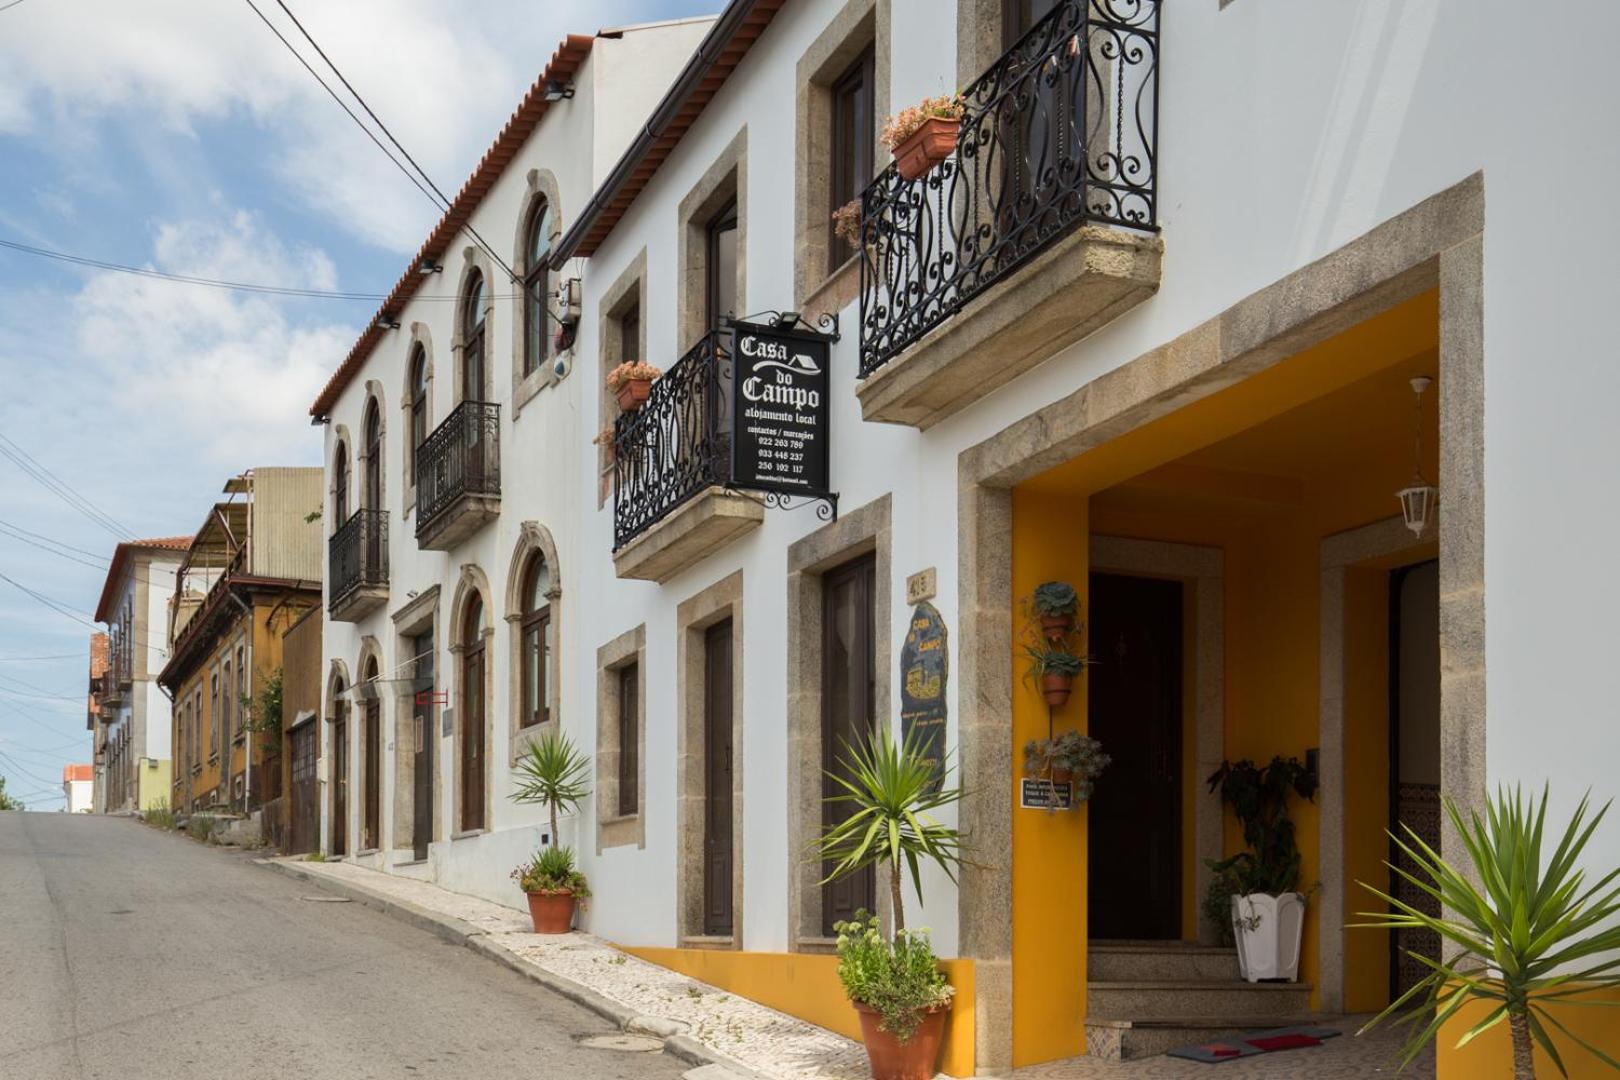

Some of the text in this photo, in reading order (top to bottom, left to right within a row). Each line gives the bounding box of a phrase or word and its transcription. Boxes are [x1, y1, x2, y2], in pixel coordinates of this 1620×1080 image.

[741, 335, 787, 360] Casa
[776, 369, 793, 385] do
[742, 376, 820, 411] Campo
[745, 407, 817, 426] alojamento local
[789, 452, 804, 461] 237
[793, 465, 804, 473] 117
